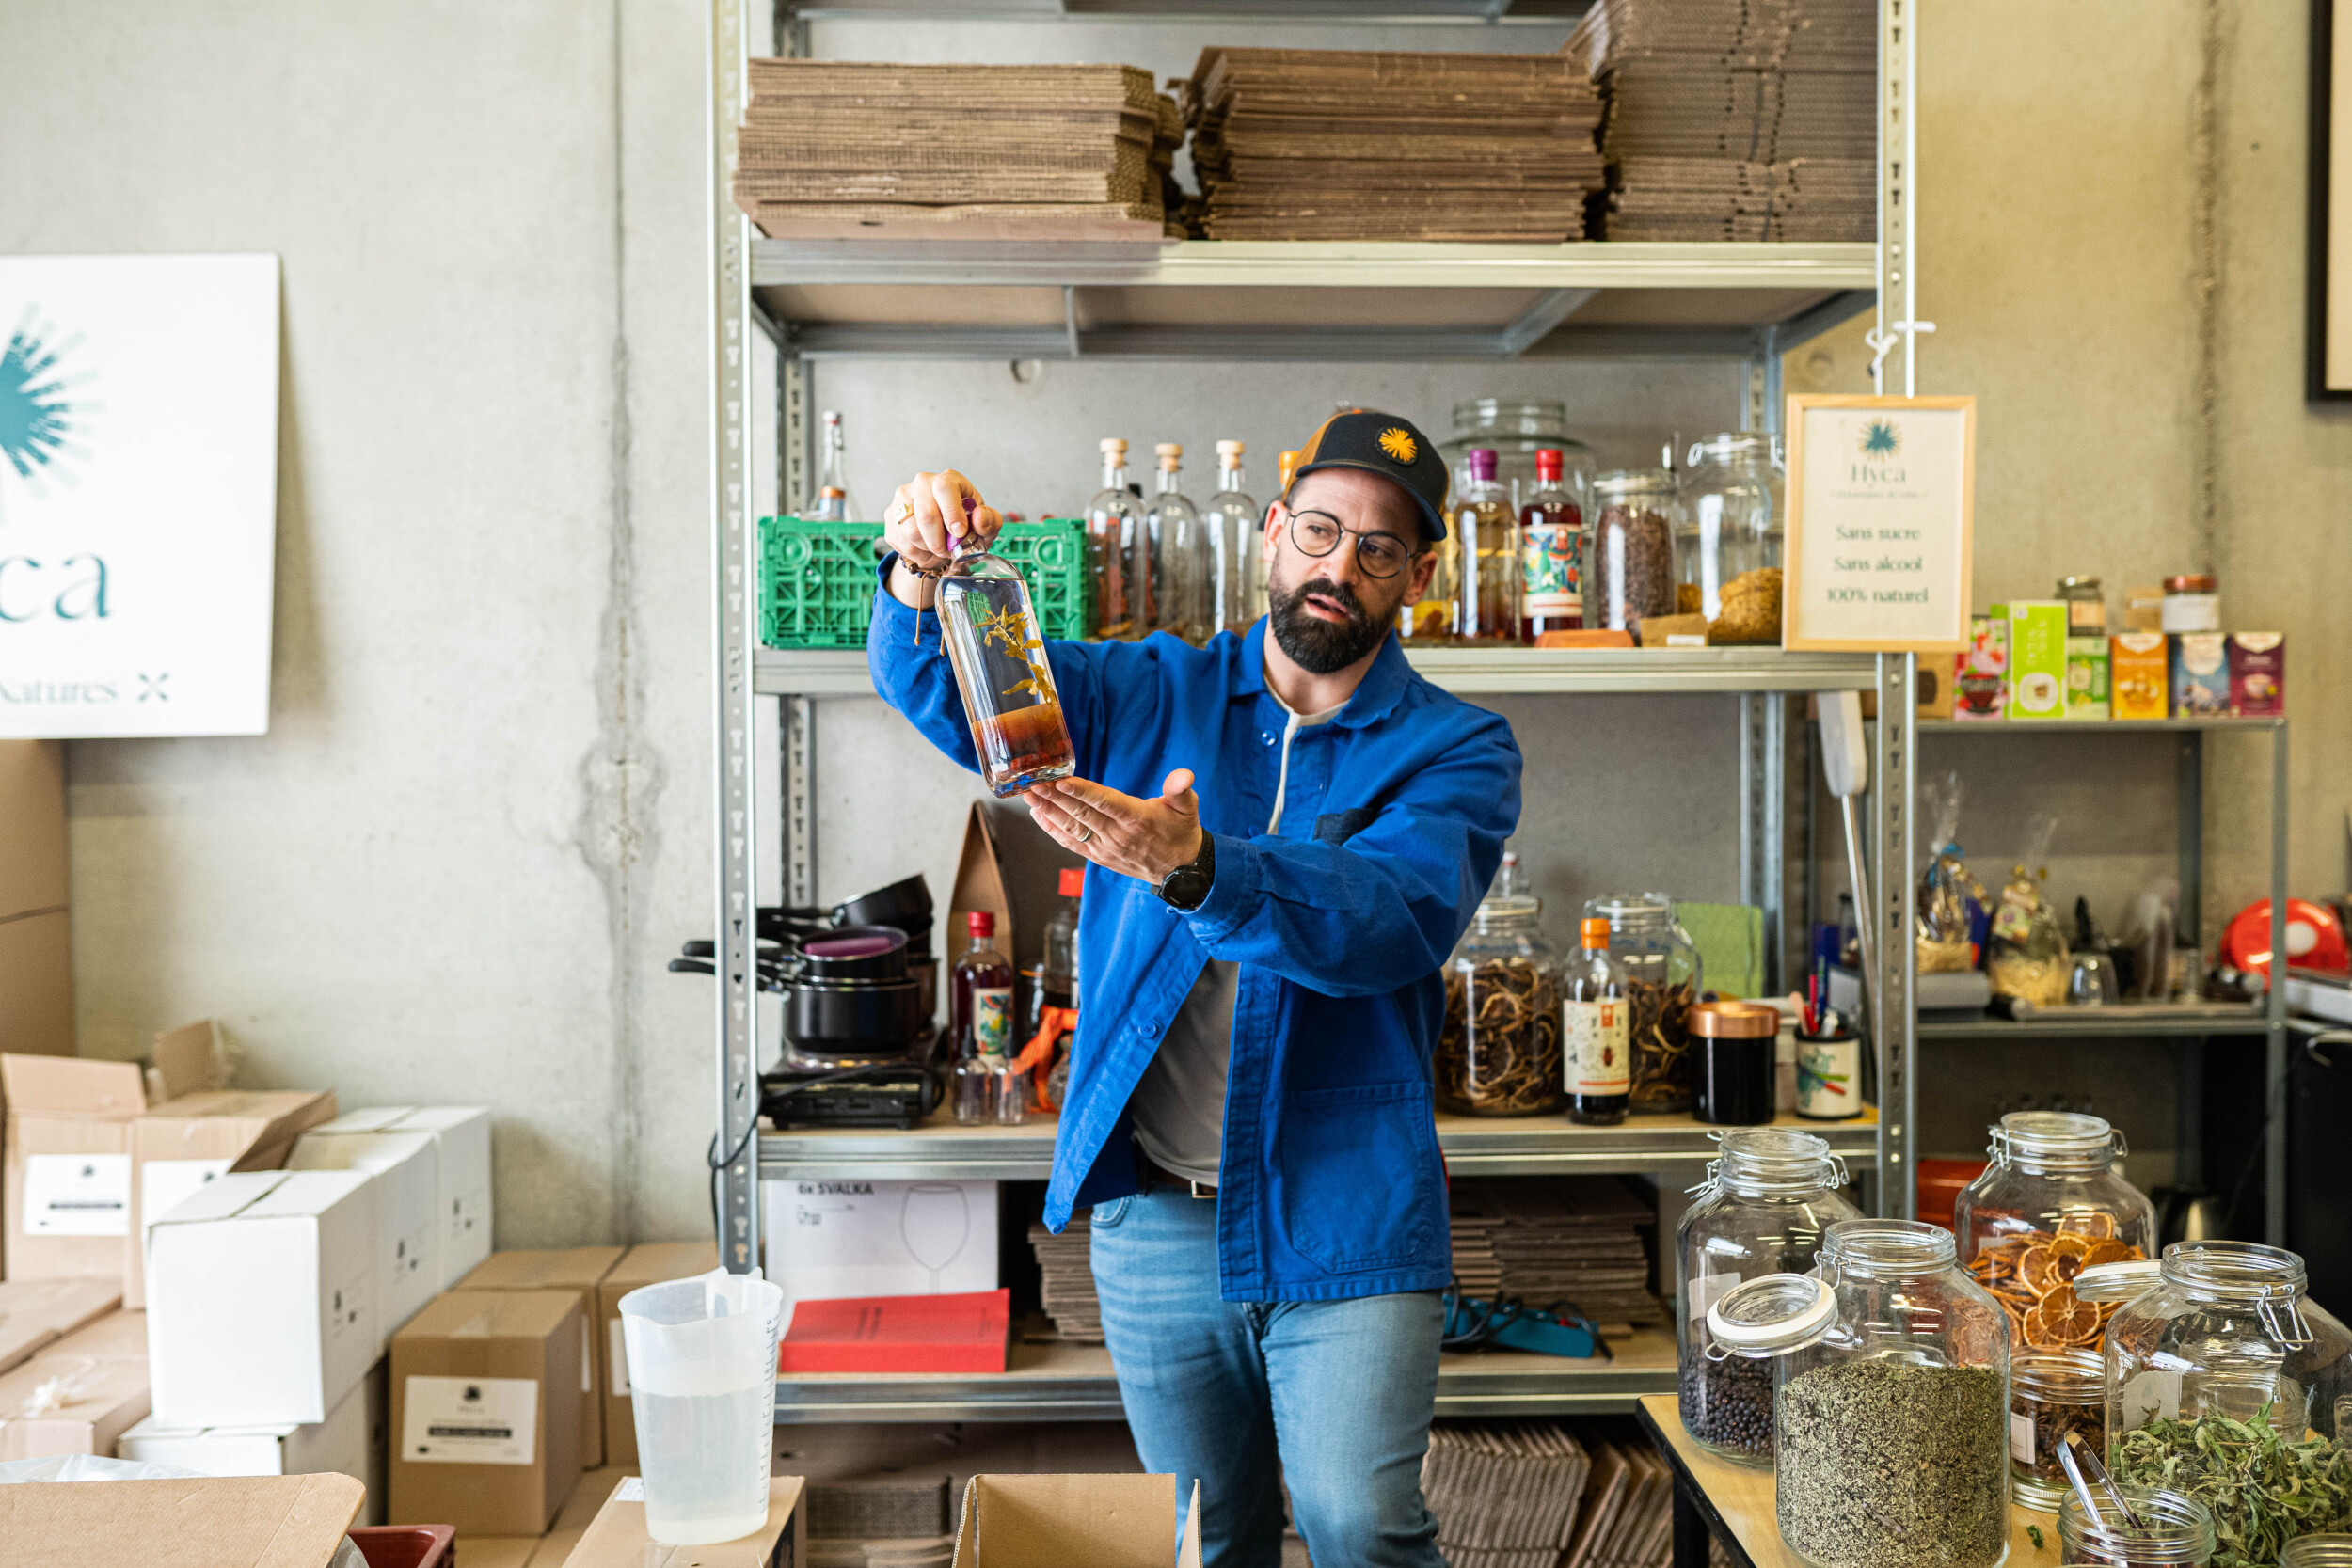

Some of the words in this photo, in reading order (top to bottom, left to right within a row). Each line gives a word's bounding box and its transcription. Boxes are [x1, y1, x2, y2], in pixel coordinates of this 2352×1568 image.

[1851, 464, 1907, 489] Hyca
[1836, 525, 1873, 541] Sans
[1879, 527, 1921, 541] sucre
[1834, 556, 1870, 572] Sans
[1875, 555, 1922, 572] alcool
[1827, 587, 1867, 603] 100%
[1872, 586, 1929, 603] naturel
